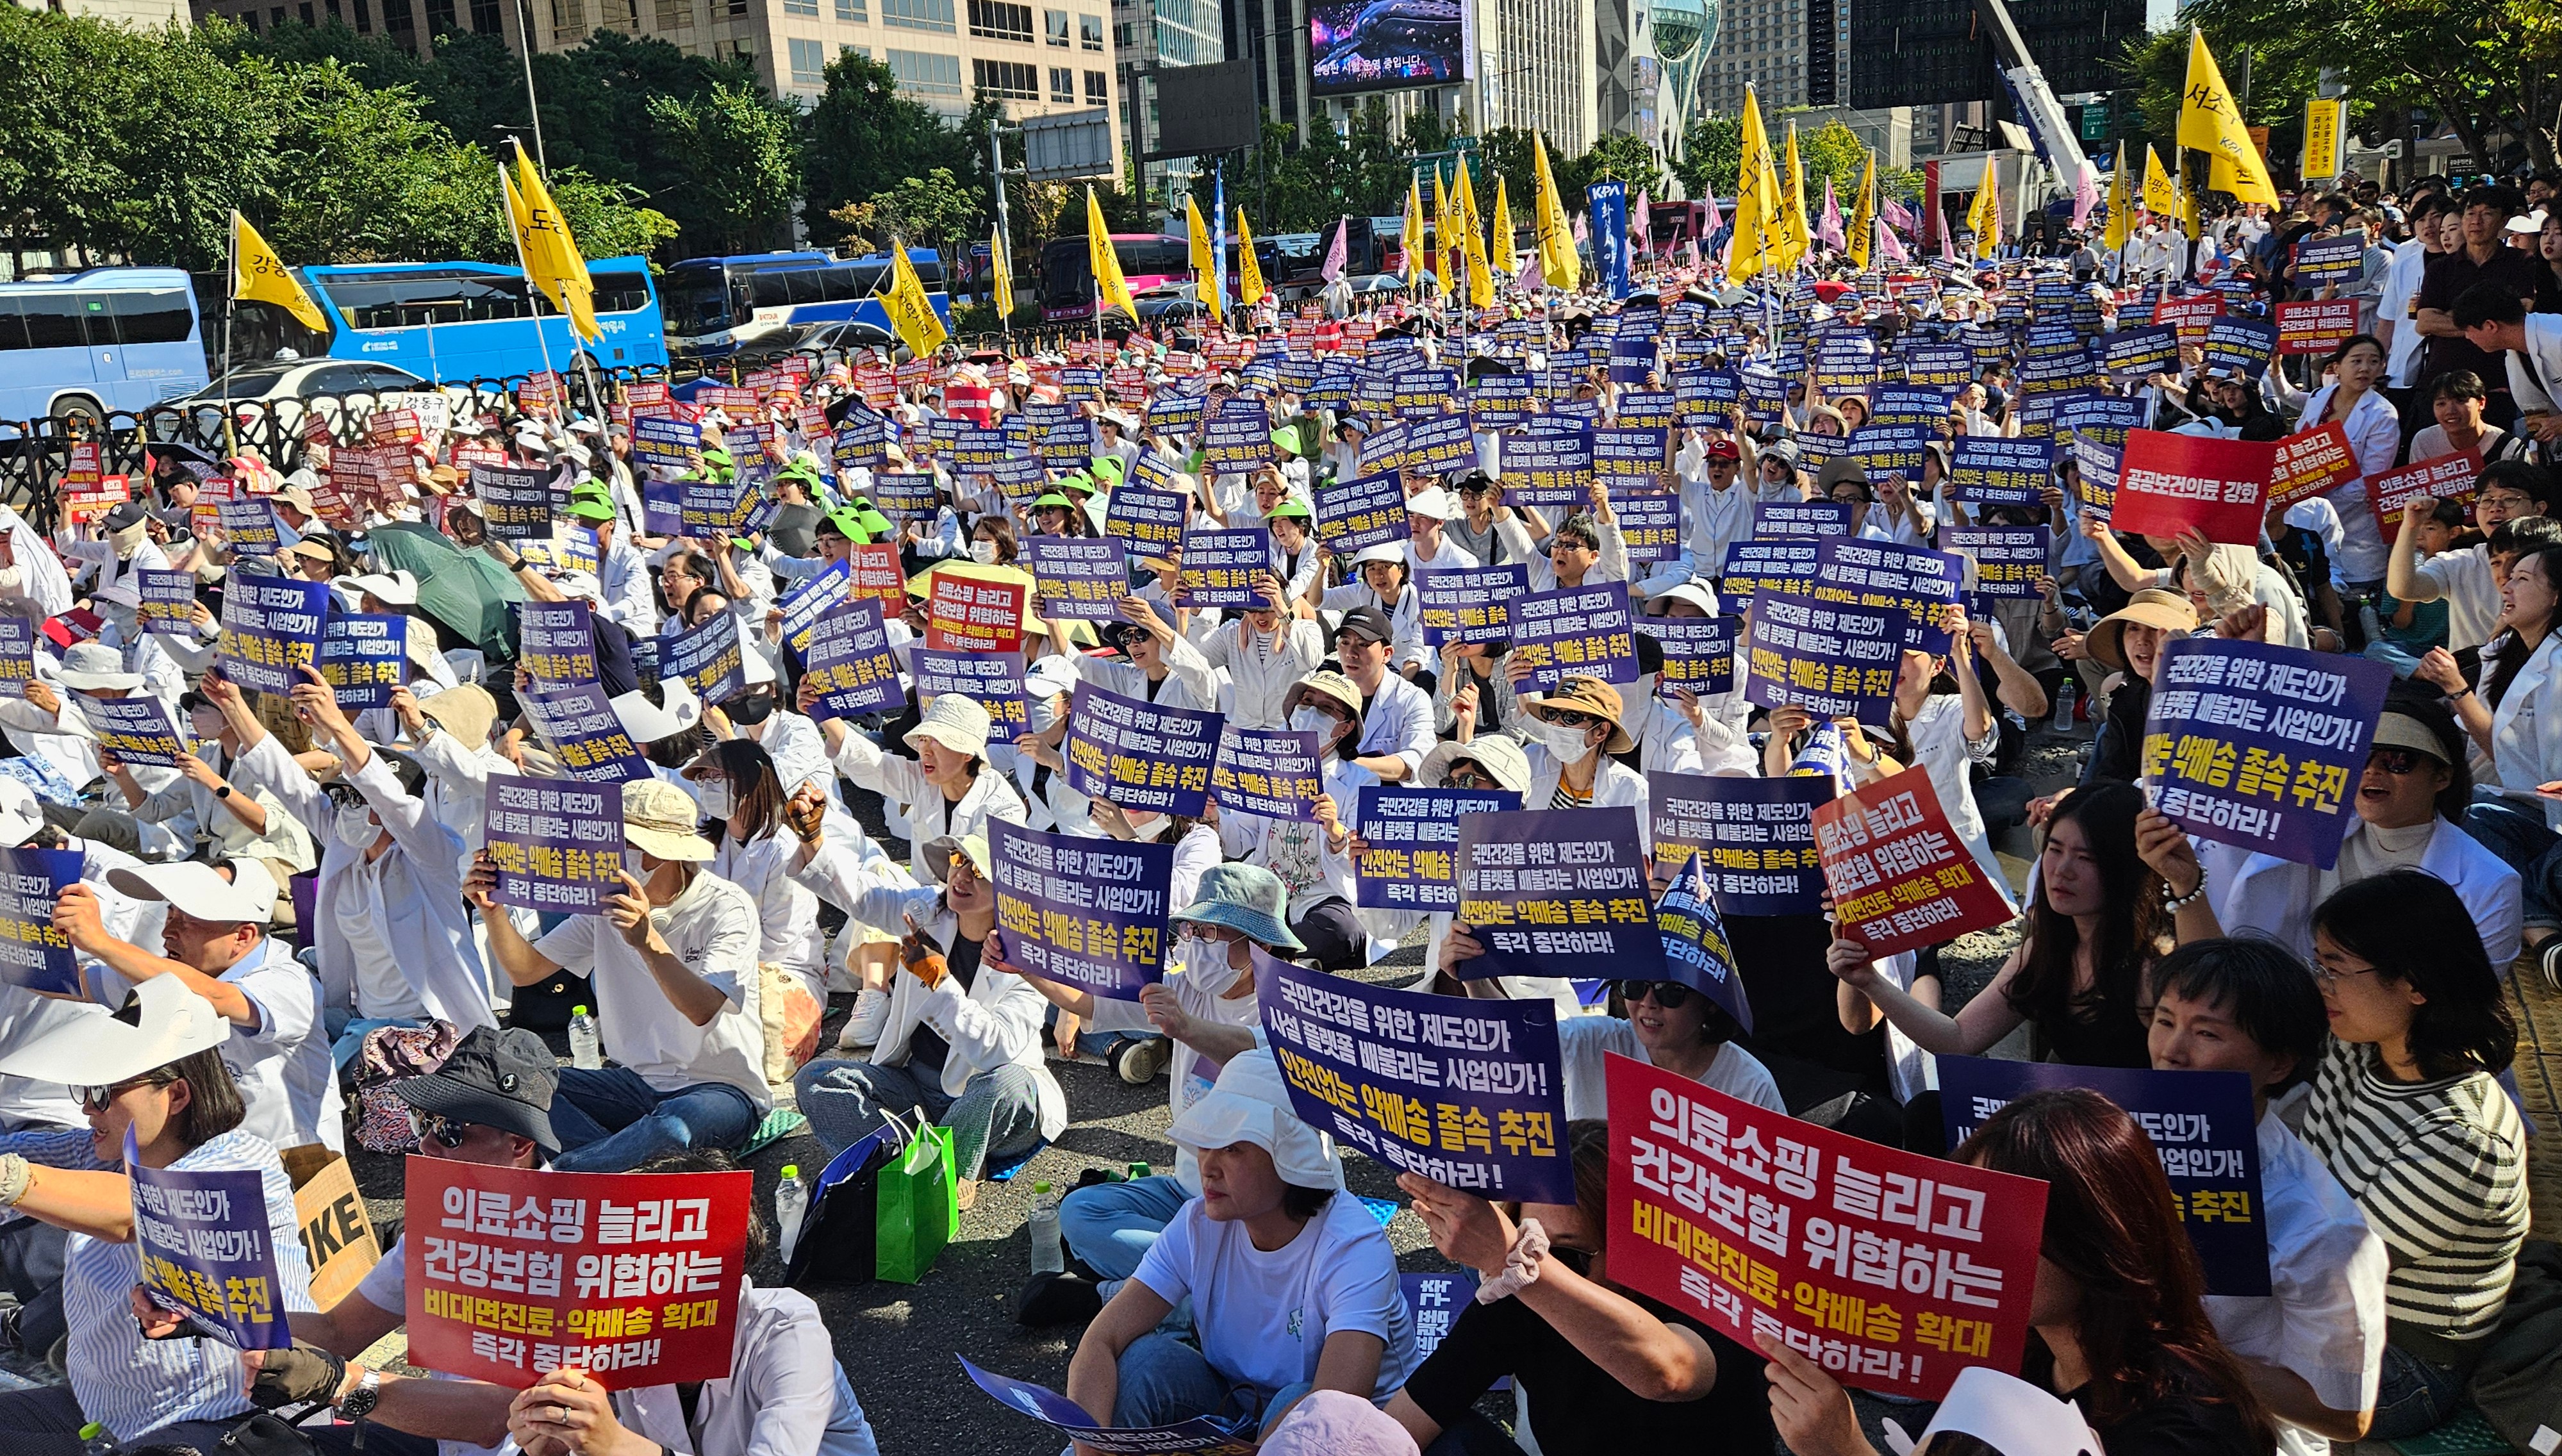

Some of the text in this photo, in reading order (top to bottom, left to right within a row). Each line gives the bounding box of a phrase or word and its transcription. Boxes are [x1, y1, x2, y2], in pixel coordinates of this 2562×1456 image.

[406, 396, 445, 410] 강동구
[418, 415, 439, 424] 사회
[2126, 468, 2259, 504] 공공보건의료 강화
[259, 587, 305, 609] 제도인가
[933, 599, 1016, 625] 건강보험 위협하는
[937, 581, 1012, 607] 의료쇼핑 늘리고
[267, 610, 318, 635] 사업인가!
[347, 622, 387, 637] 제도인가
[932, 618, 1015, 639] 비대면진료·약배송 확대
[943, 633, 996, 649] 즉각 중단하라!
[356, 640, 400, 656] 사업인가!
[376, 661, 400, 684] 추진
[2167, 655, 2347, 707] 국민건강을 위한 제도인가
[2195, 692, 2267, 732] 배불리는
[2267, 706, 2363, 752] 사업인가!
[2172, 734, 2238, 788] 약배송
[2236, 747, 2290, 802] 졸속
[2291, 759, 2349, 815] 추진
[499, 785, 602, 815] 국민건강을 위한 제도인가
[1863, 790, 1924, 840] 늘리고
[2161, 786, 2282, 840] 중단하라!
[488, 810, 618, 842] 사설 플랫폼 배불리는 사업인가!
[529, 845, 563, 878] 약배송
[566, 848, 591, 881] 졸속
[595, 850, 622, 882] 추진
[1004, 833, 1143, 882] 국민건강을 위한 제도인가
[1472, 841, 1614, 865] 국민건강을 위한 제도인가
[1874, 830, 1955, 878] 위협하는
[508, 879, 597, 906] 즉각 중단하라!
[996, 859, 1161, 915] 사설 플랫폼 배불리는 사업인가!
[1460, 868, 1639, 891] 사설 플랫폼 배불리는 사업인가!
[1936, 863, 1974, 889] 확대
[997, 892, 1159, 965] 안전없는 약배송 졸속 추진
[1460, 898, 1648, 925] 안전없는 약배송 졸속 추진
[1861, 897, 1963, 941] 즉각 중단하라!
[1492, 932, 1616, 953] 즉각 중단하라!
[1021, 941, 1121, 989] 즉각 중단하라!
[1278, 975, 1511, 1053] 국민건강을 위한 제도인가
[1269, 1005, 1547, 1096] 사설 플랫폼 배불리는 사업인가!
[1278, 1047, 1557, 1157] 안전없는 약배송 졸속 추진
[1332, 1112, 1503, 1189] 즉각 중단하라!
[1650, 1088, 1986, 1242] 의료쇼핑 늘리고
[2160, 1148, 2244, 1178] 업인가!
[139, 1182, 230, 1221] 위한 제도인가
[441, 1186, 709, 1244] 의료쇼핑 늘리고
[2192, 1189, 2251, 1223] 추진
[1631, 1136, 2003, 1309] 건강보험 위협하는
[188, 1229, 261, 1262] 사업인가!
[424, 1237, 722, 1298] 건강보험 위협하는
[1633, 1199, 1992, 1357] 비대면진료·약배송 확대
[226, 1276, 273, 1323] 추진
[424, 1288, 718, 1339] 비대면진료·약배송 확대
[1680, 1265, 1744, 1328] 즉각
[472, 1331, 661, 1375] 즉각 중단하라!
